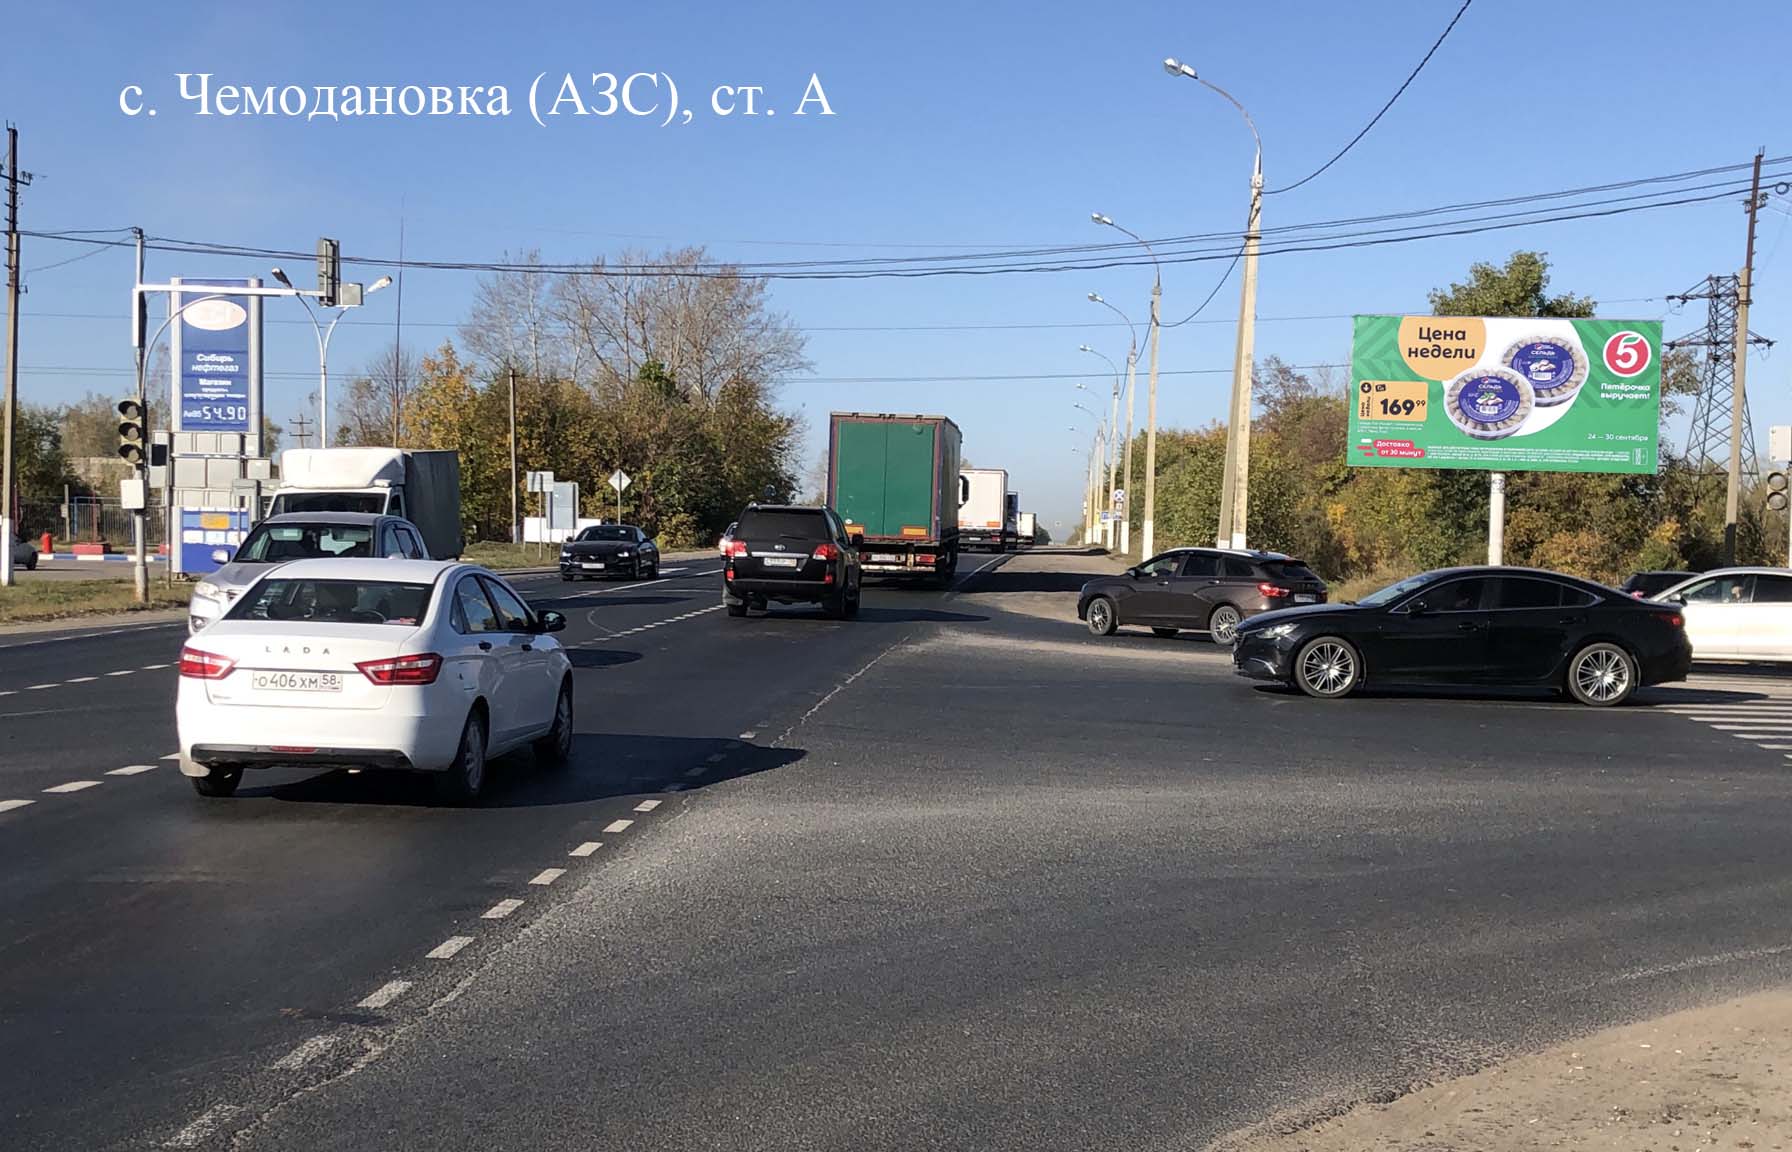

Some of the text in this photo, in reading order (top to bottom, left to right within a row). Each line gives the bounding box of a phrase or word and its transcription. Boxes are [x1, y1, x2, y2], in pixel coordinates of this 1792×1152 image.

[1418, 326, 1467, 342] Цена
[1408, 345, 1476, 359] недели
[1615, 335, 1641, 368] 5
[196, 353, 234, 363] Сибирь
[1600, 382, 1651, 392] Пятёрочка
[1600, 392, 1650, 400] выручает!
[1380, 398, 1415, 416] 169
[1376, 440, 1410, 448] Доставка
[266, 646, 330, 655] LADA
